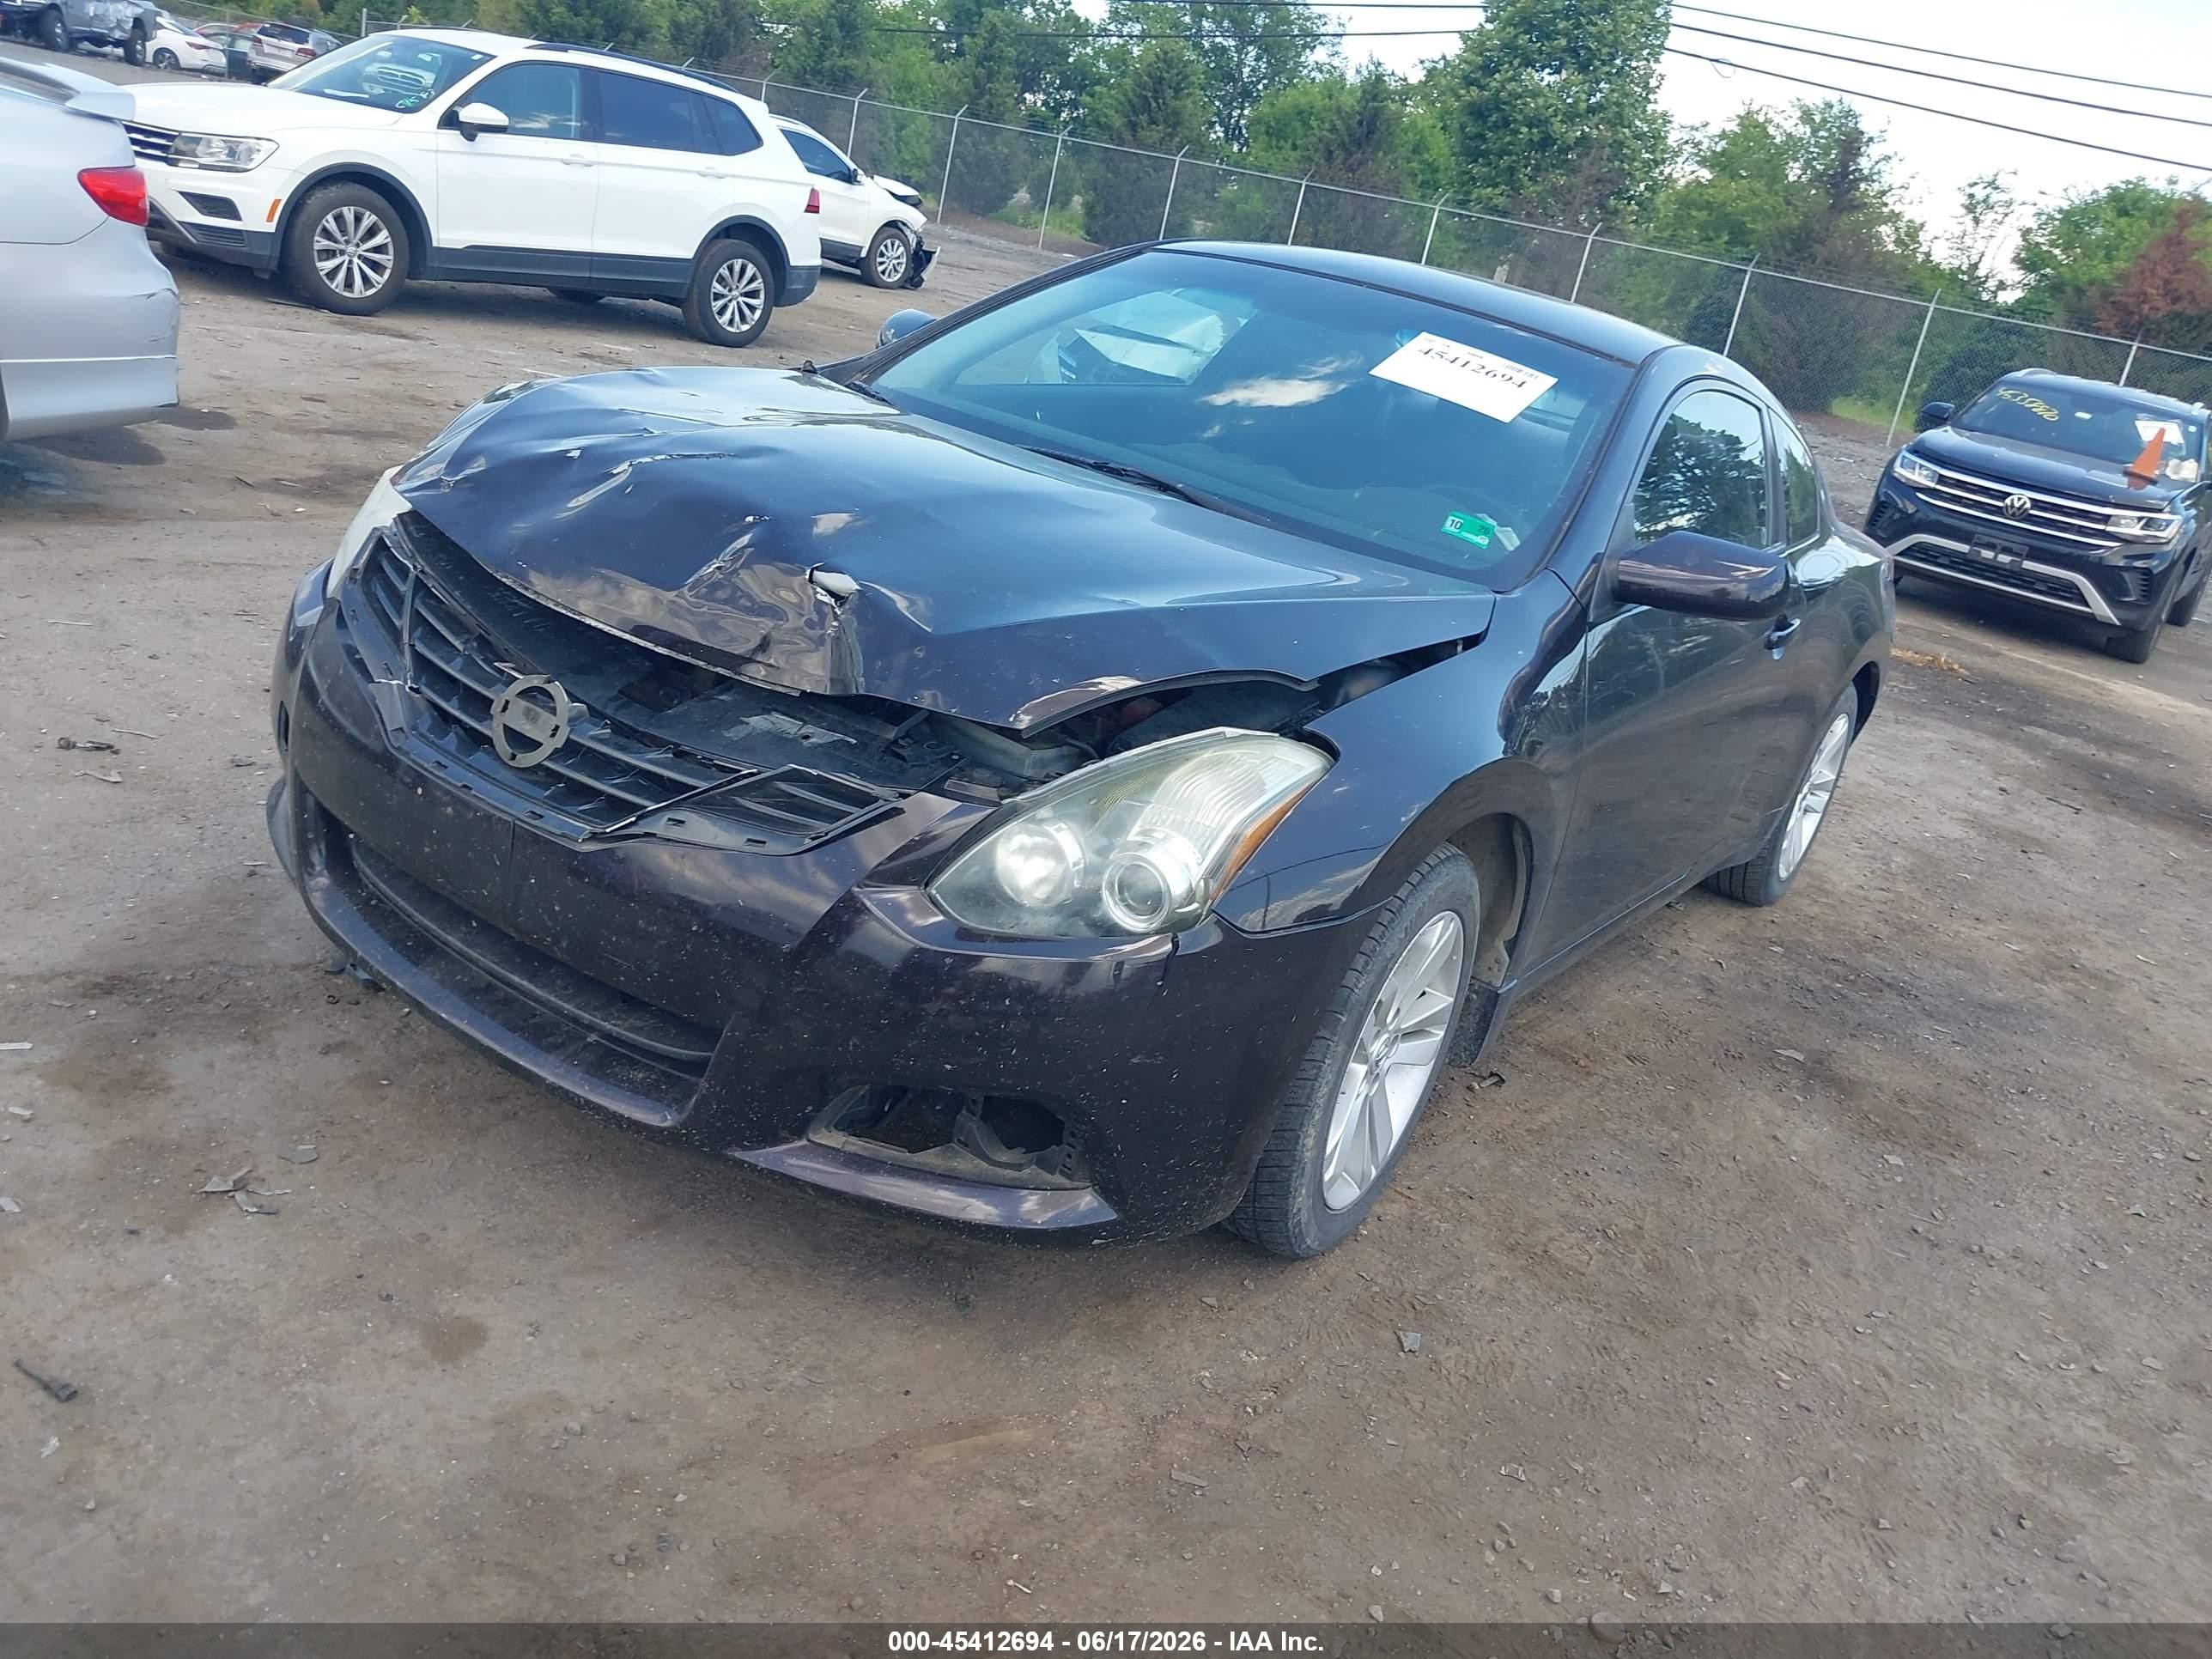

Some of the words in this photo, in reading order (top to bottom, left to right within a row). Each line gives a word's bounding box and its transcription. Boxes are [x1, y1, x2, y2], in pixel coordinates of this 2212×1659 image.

[1417, 346, 1528, 389] 45412694
[2002, 494, 2032, 520] VW
[1449, 518, 1464, 531] 10
